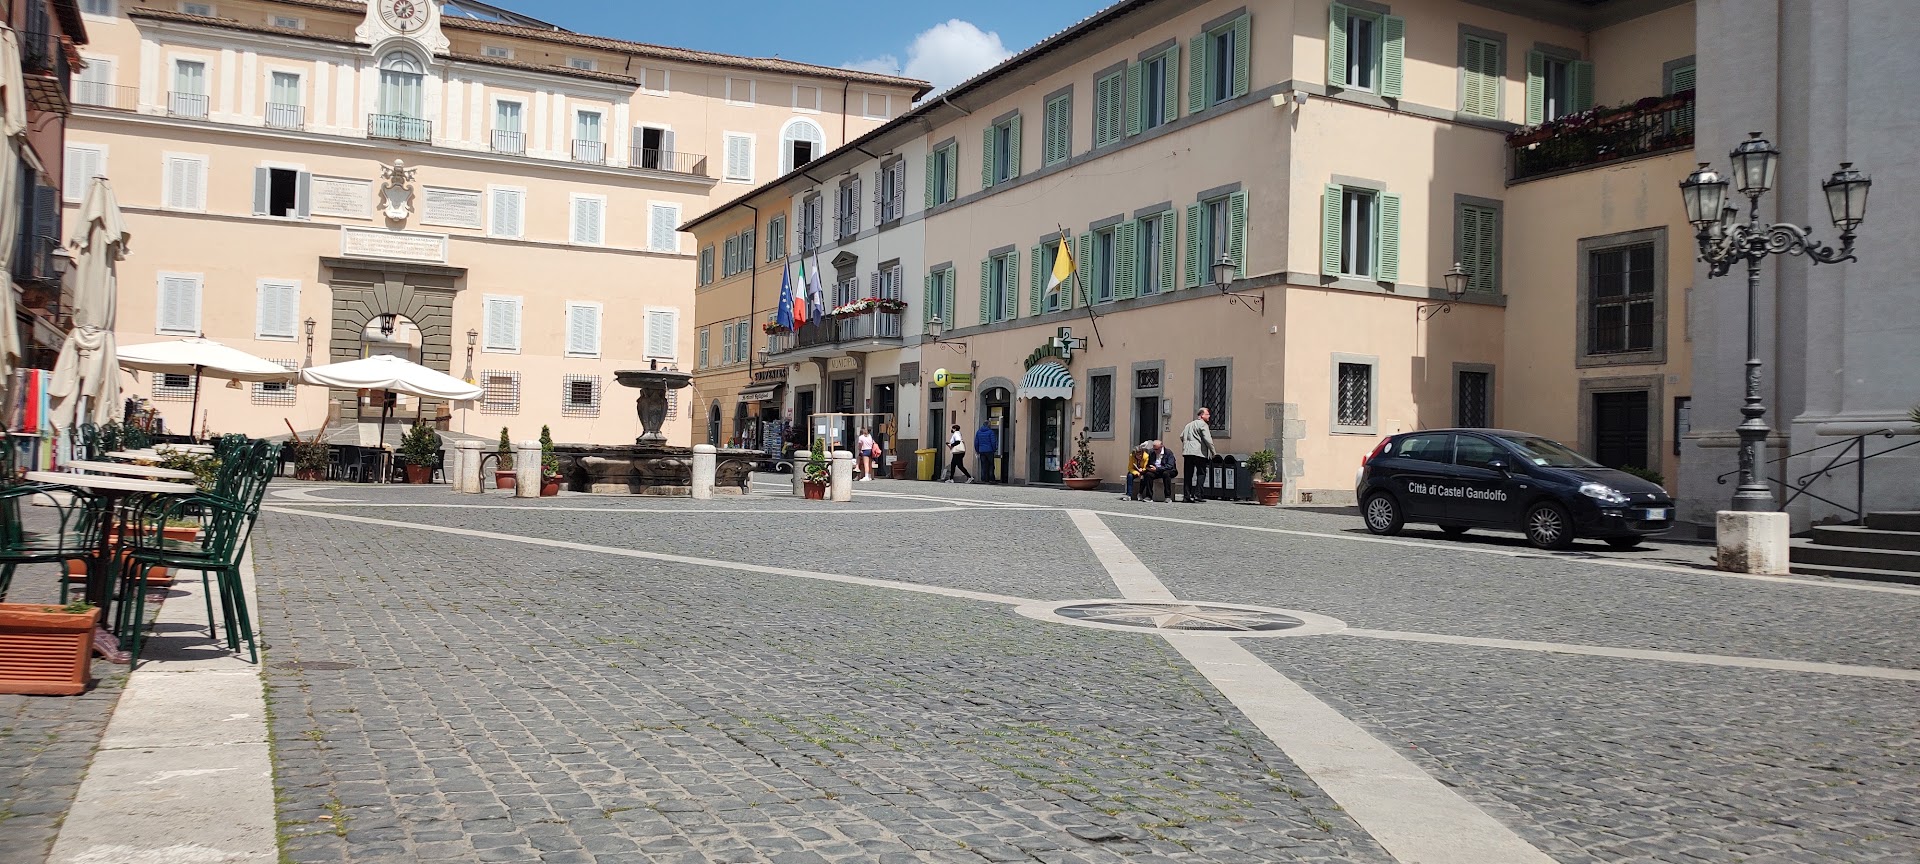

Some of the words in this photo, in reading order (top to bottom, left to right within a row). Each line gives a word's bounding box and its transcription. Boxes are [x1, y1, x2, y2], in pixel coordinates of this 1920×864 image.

[937, 373, 949, 382] PT
[1408, 482, 1427, 494] Città
[1428, 484, 1437, 495] di
[1438, 485, 1465, 497] Castel
[1466, 486, 1508, 502] Gandolfo
